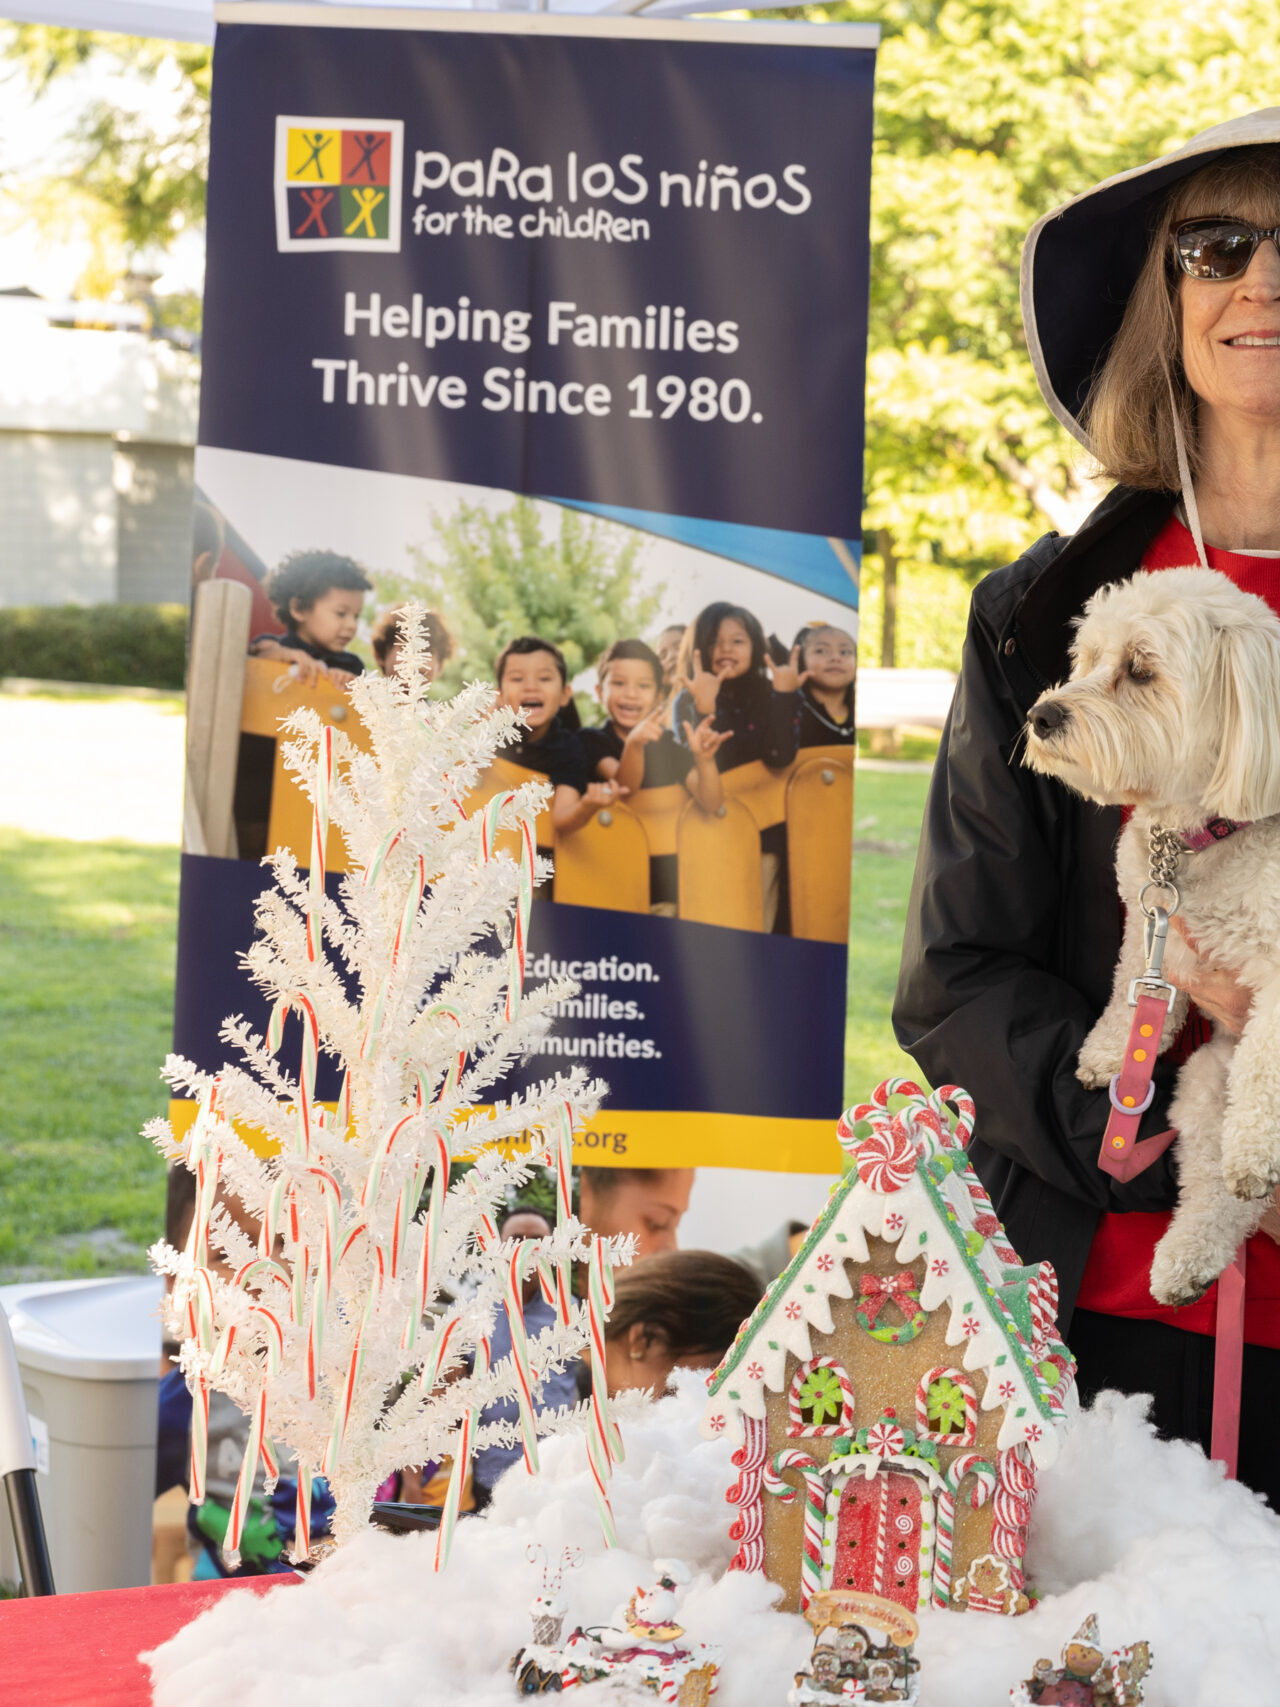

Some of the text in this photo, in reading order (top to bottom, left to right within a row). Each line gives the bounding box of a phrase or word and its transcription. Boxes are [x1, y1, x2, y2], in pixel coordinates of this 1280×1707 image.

[412, 204, 459, 236] for
[461, 204, 514, 240] the
[344, 291, 740, 354] Helping Families
[311, 358, 763, 424] Thrive Since 1980.
[523, 952, 660, 983] Education.
[546, 993, 645, 1020] amilies.
[539, 1031, 662, 1059] munities.
